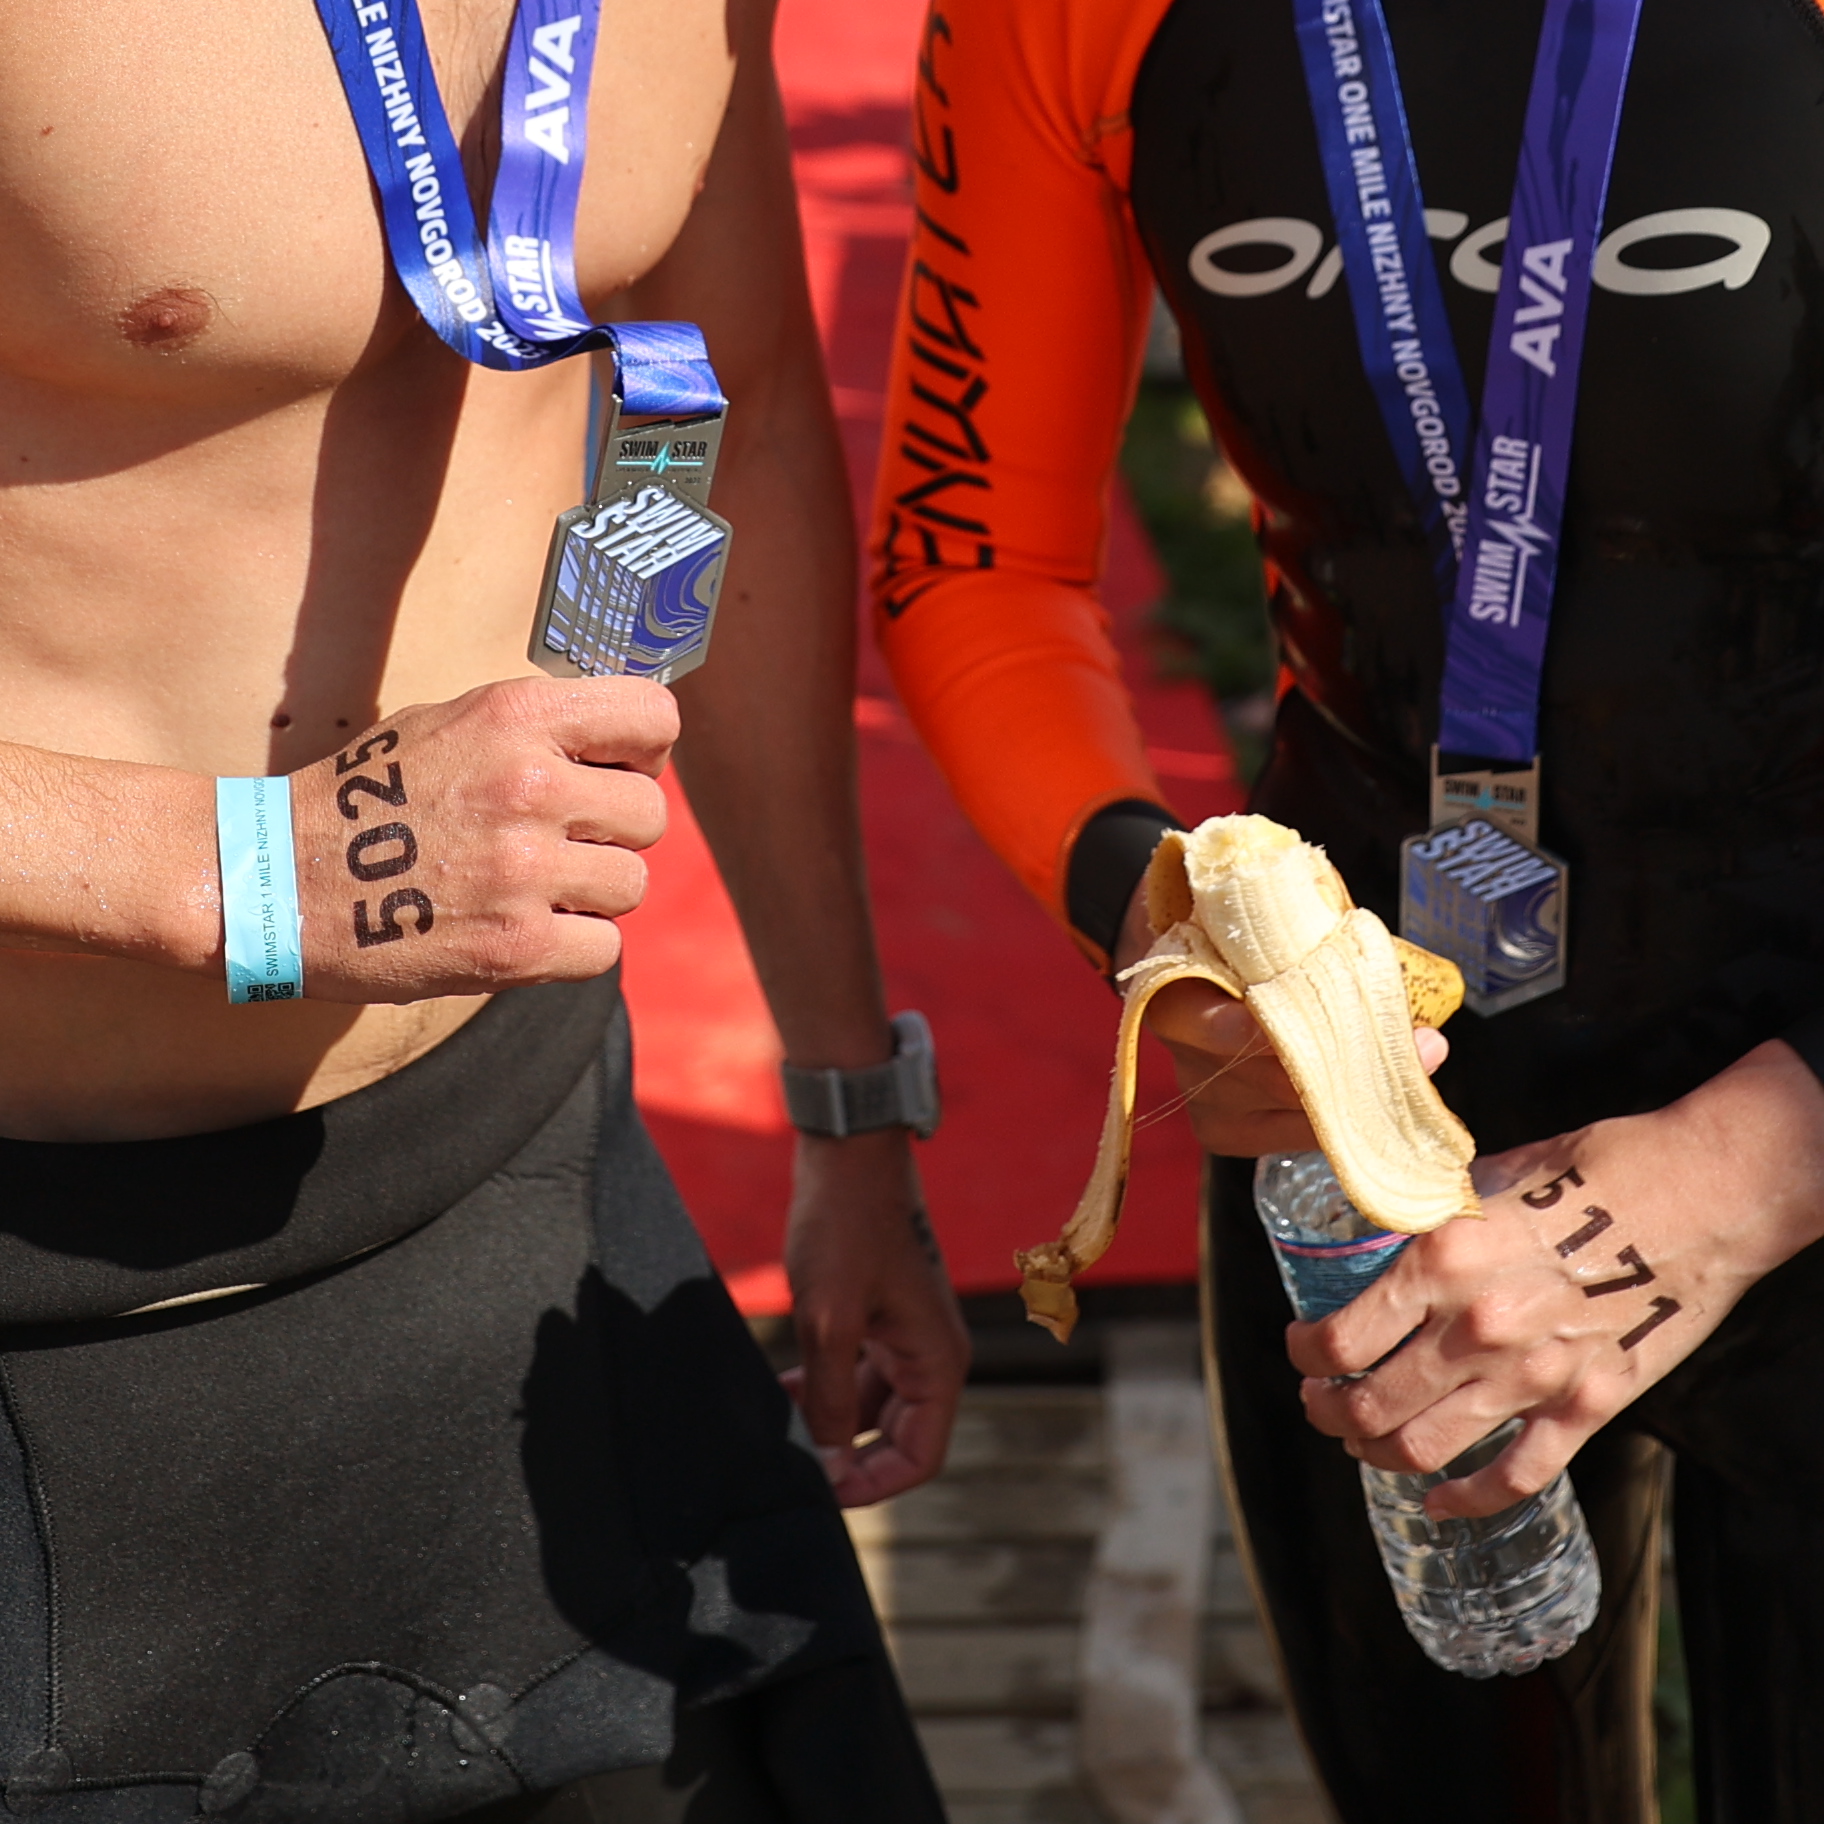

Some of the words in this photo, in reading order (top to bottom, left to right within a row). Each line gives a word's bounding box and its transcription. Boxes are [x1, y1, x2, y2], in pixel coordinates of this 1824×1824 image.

[524, 14, 582, 165] AVA
[1338, 81, 1376, 145] ONE
[365, 28, 426, 149] NIZHNY
[405, 152, 488, 323] NOVGOROD
[1350, 145, 1392, 220] MILE
[504, 235, 549, 312] STAR
[1366, 222, 1417, 332] NIZHNY
[1509, 237, 1574, 377] AVA
[619, 441, 660, 457] SWIM
[672, 441, 707, 457] STAR
[1391, 338, 1461, 498] NOVGOROD
[1484, 434, 1529, 514] STAR
[569, 501, 679, 580] STAR
[623, 487, 725, 550] SWIM
[1469, 538, 1516, 624] SWIM
[255, 808, 268, 850] NIZHNY
[336, 730, 434, 948] 5025
[1410, 831, 1514, 904] STAR
[1463, 819, 1559, 885] SWIM
[257, 853, 272, 887] MILE
[261, 890, 272, 898] 1
[262, 903, 279, 977] SWIMSTAR
[1520, 1165, 1683, 1352] 5171
